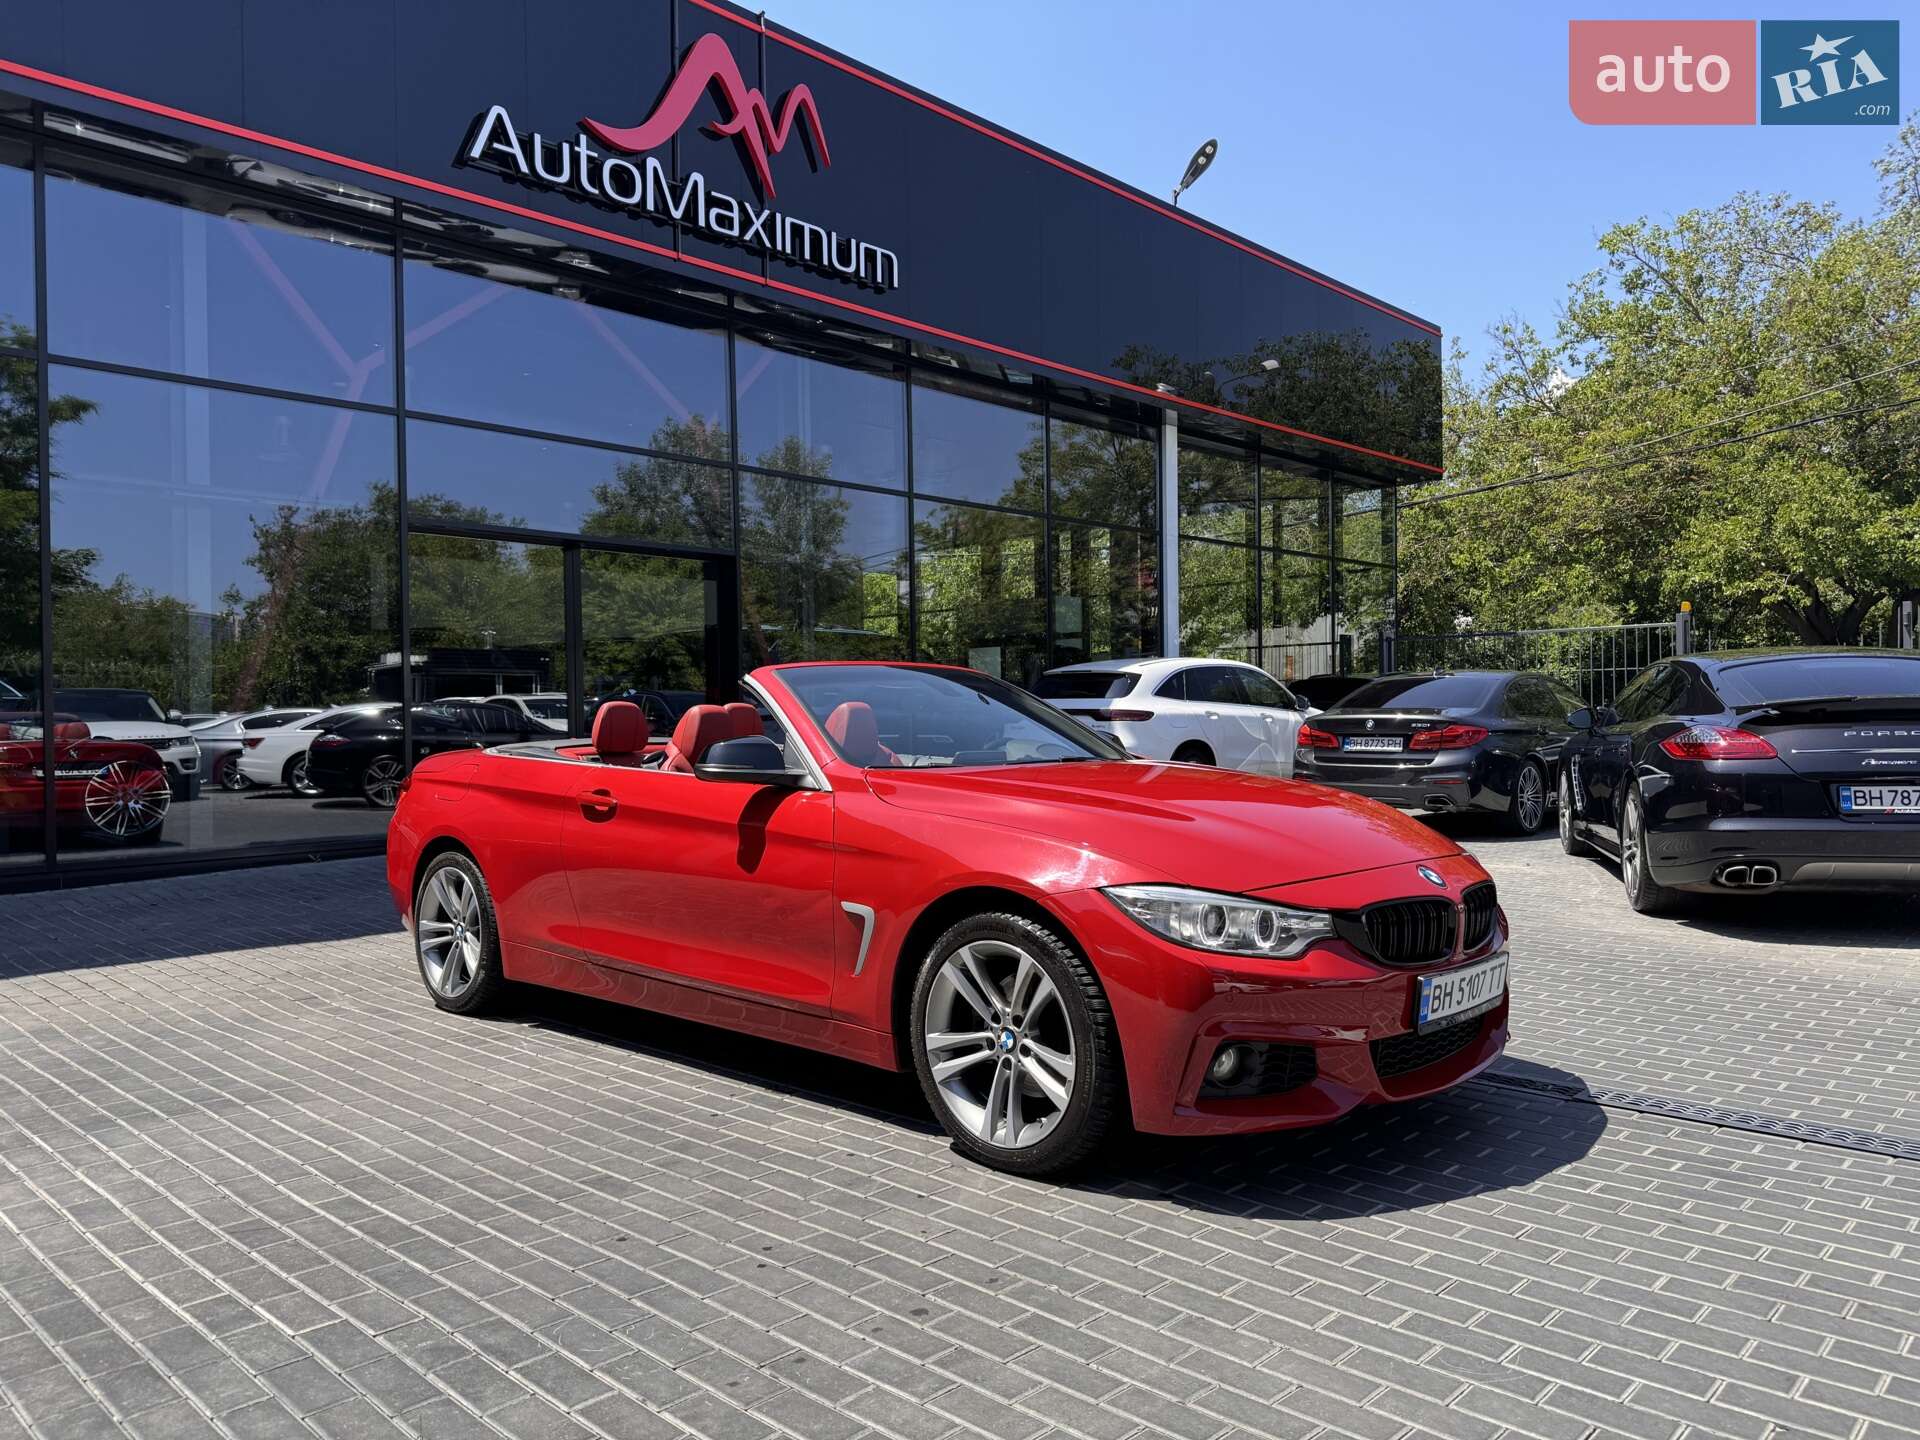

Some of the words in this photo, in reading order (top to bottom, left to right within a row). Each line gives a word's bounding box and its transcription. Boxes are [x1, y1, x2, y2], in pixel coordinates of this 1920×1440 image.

[469, 104, 899, 289] AutoMaximum
[1349, 739, 1362, 749] BH
[1364, 738, 1386, 749] 8775
[1387, 739, 1402, 748] PH
[1853, 789, 1884, 807] BH
[1887, 789, 1920, 807] 787
[1431, 980, 1454, 1014] BH
[1456, 970, 1487, 1005] 5107
[1489, 961, 1505, 993] TT
